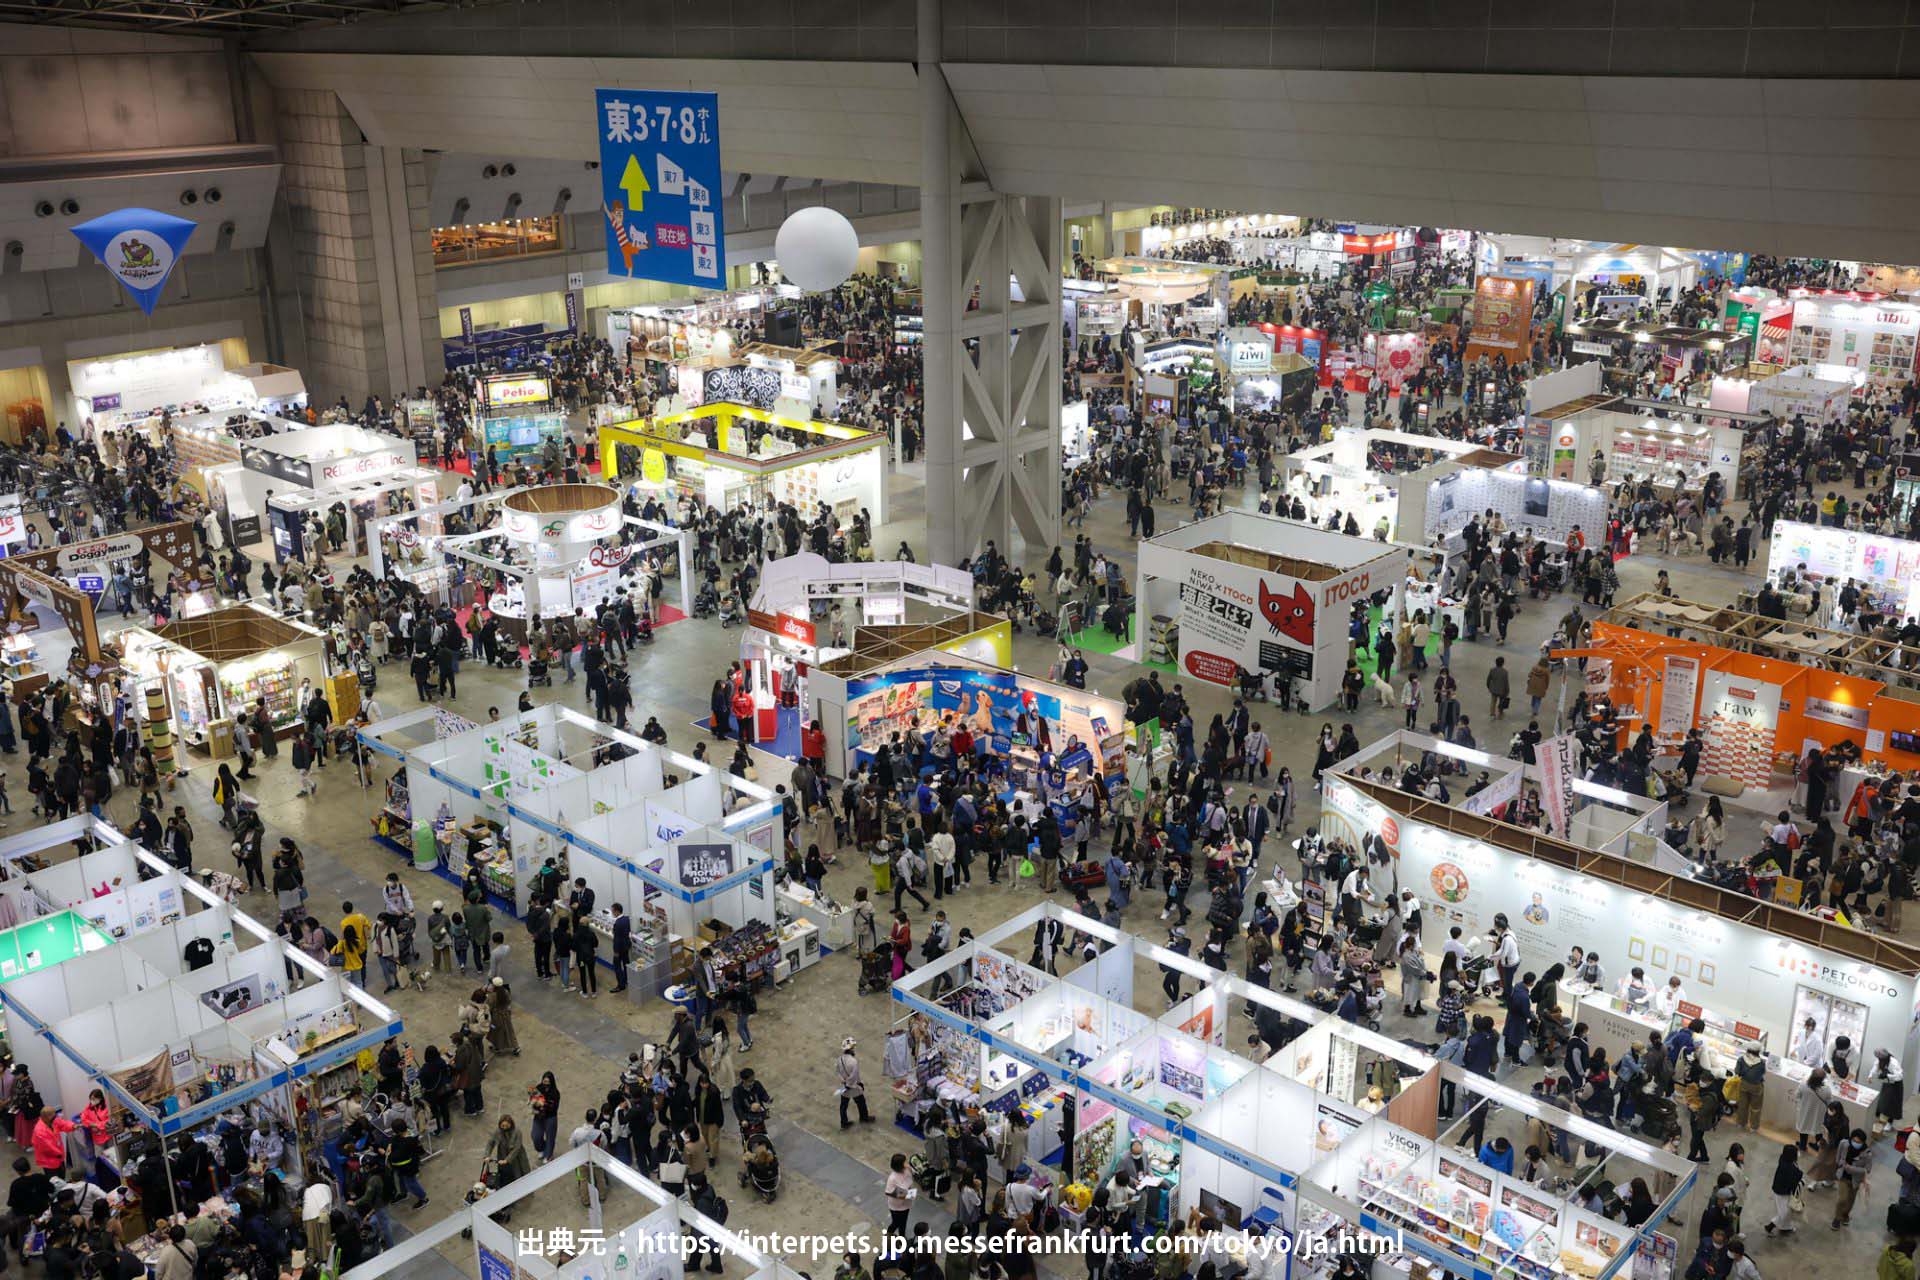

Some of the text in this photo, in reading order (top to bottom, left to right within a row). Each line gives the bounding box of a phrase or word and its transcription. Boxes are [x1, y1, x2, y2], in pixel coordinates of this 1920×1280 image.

[663, 170, 678, 184] 東7
[692, 188, 706, 202] 東8
[657, 227, 687, 246] 現在地
[695, 222, 710, 236] 東3
[698, 256, 712, 270] 東2
[1239, 351, 1264, 360] ZIWI
[68, 542, 131, 562] DoggyMan
[589, 545, 633, 568] Q-Pet
[1190, 567, 1215, 584] NEKO
[1189, 576, 1213, 592] NIWA
[1324, 571, 1370, 608] ITOCO
[1724, 701, 1757, 718] raw
[690, 868, 720, 878] north
[693, 874, 715, 885] paw
[1822, 966, 1898, 998] PETOKOTO
[1389, 1131, 1421, 1153] VIGOR
